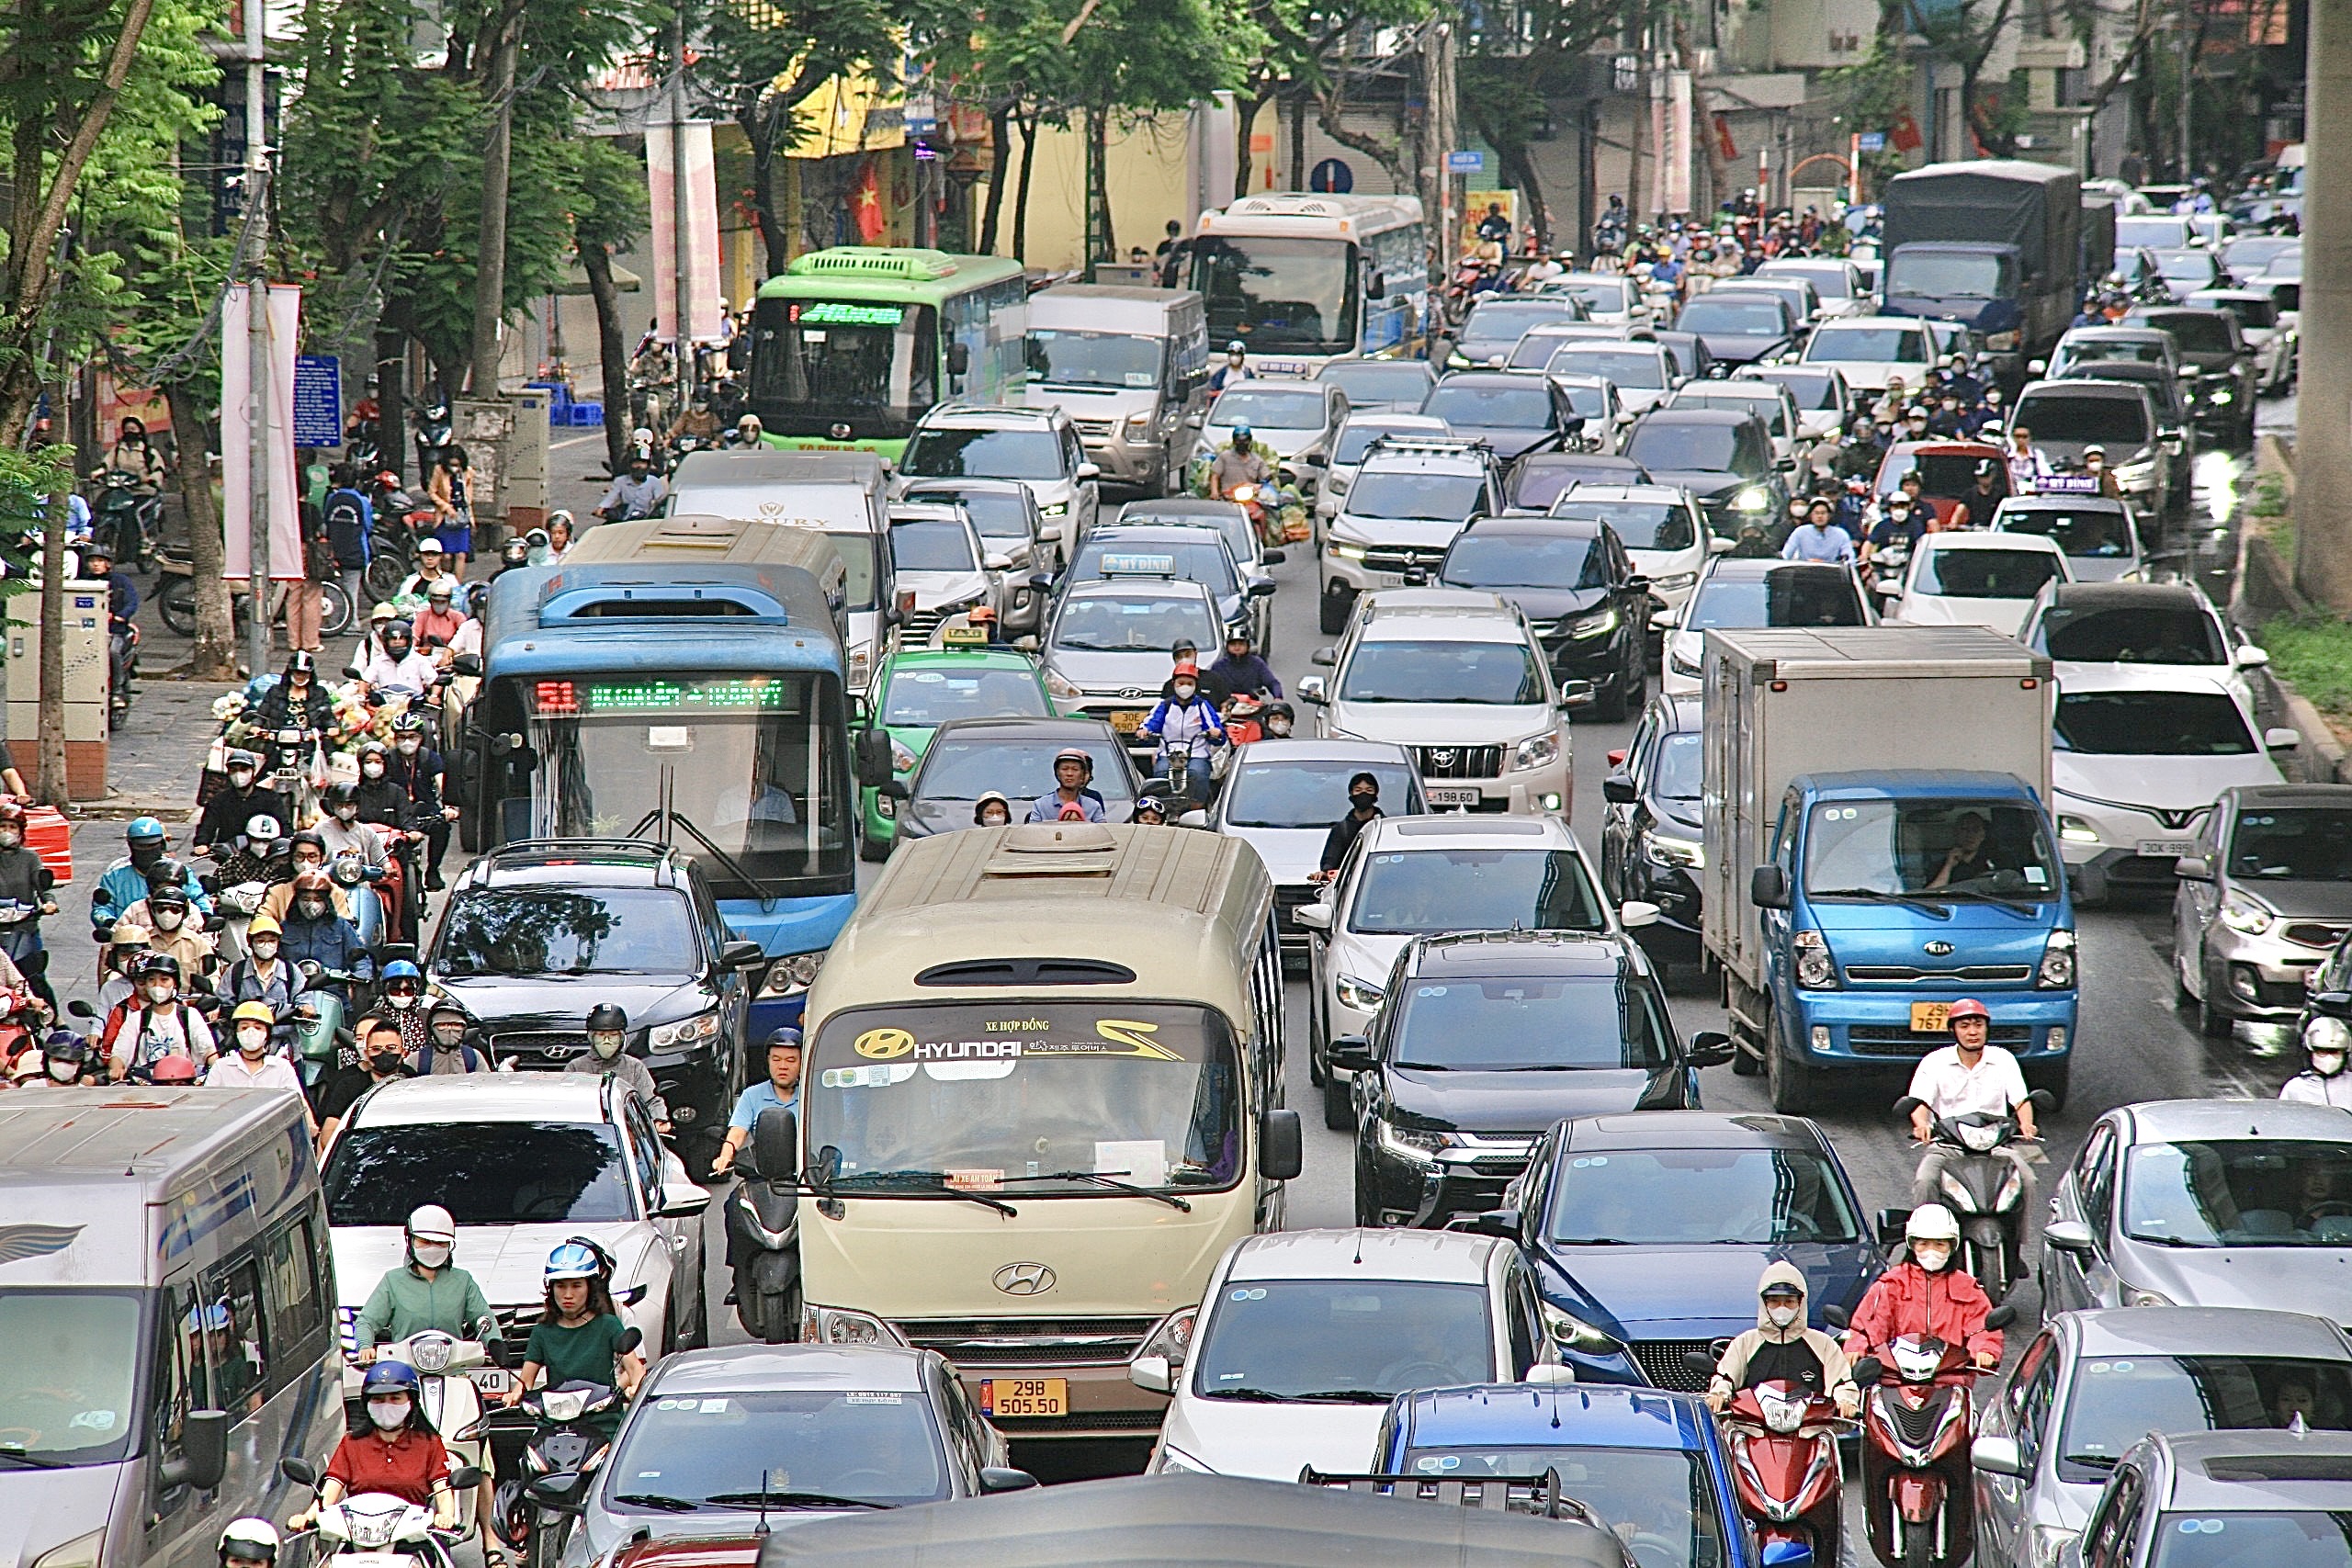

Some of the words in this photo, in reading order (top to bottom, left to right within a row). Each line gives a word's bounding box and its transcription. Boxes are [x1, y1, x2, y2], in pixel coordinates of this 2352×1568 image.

[949, 629, 981, 637] TAXI
[1122, 713, 1140, 722] 30E
[1928, 943, 1951, 953] KIA
[985, 1021, 998, 1032] XE
[1000, 1021, 1020, 1033] HỢP
[1022, 1017, 1049, 1031] ĐỒNG
[913, 1041, 1022, 1058] HYUNDAI
[961, 1175, 969, 1183] XE
[970, 1175, 980, 1183] AN
[1013, 1381, 1045, 1396] 29B
[1000, 1398, 1058, 1414] 505.50
